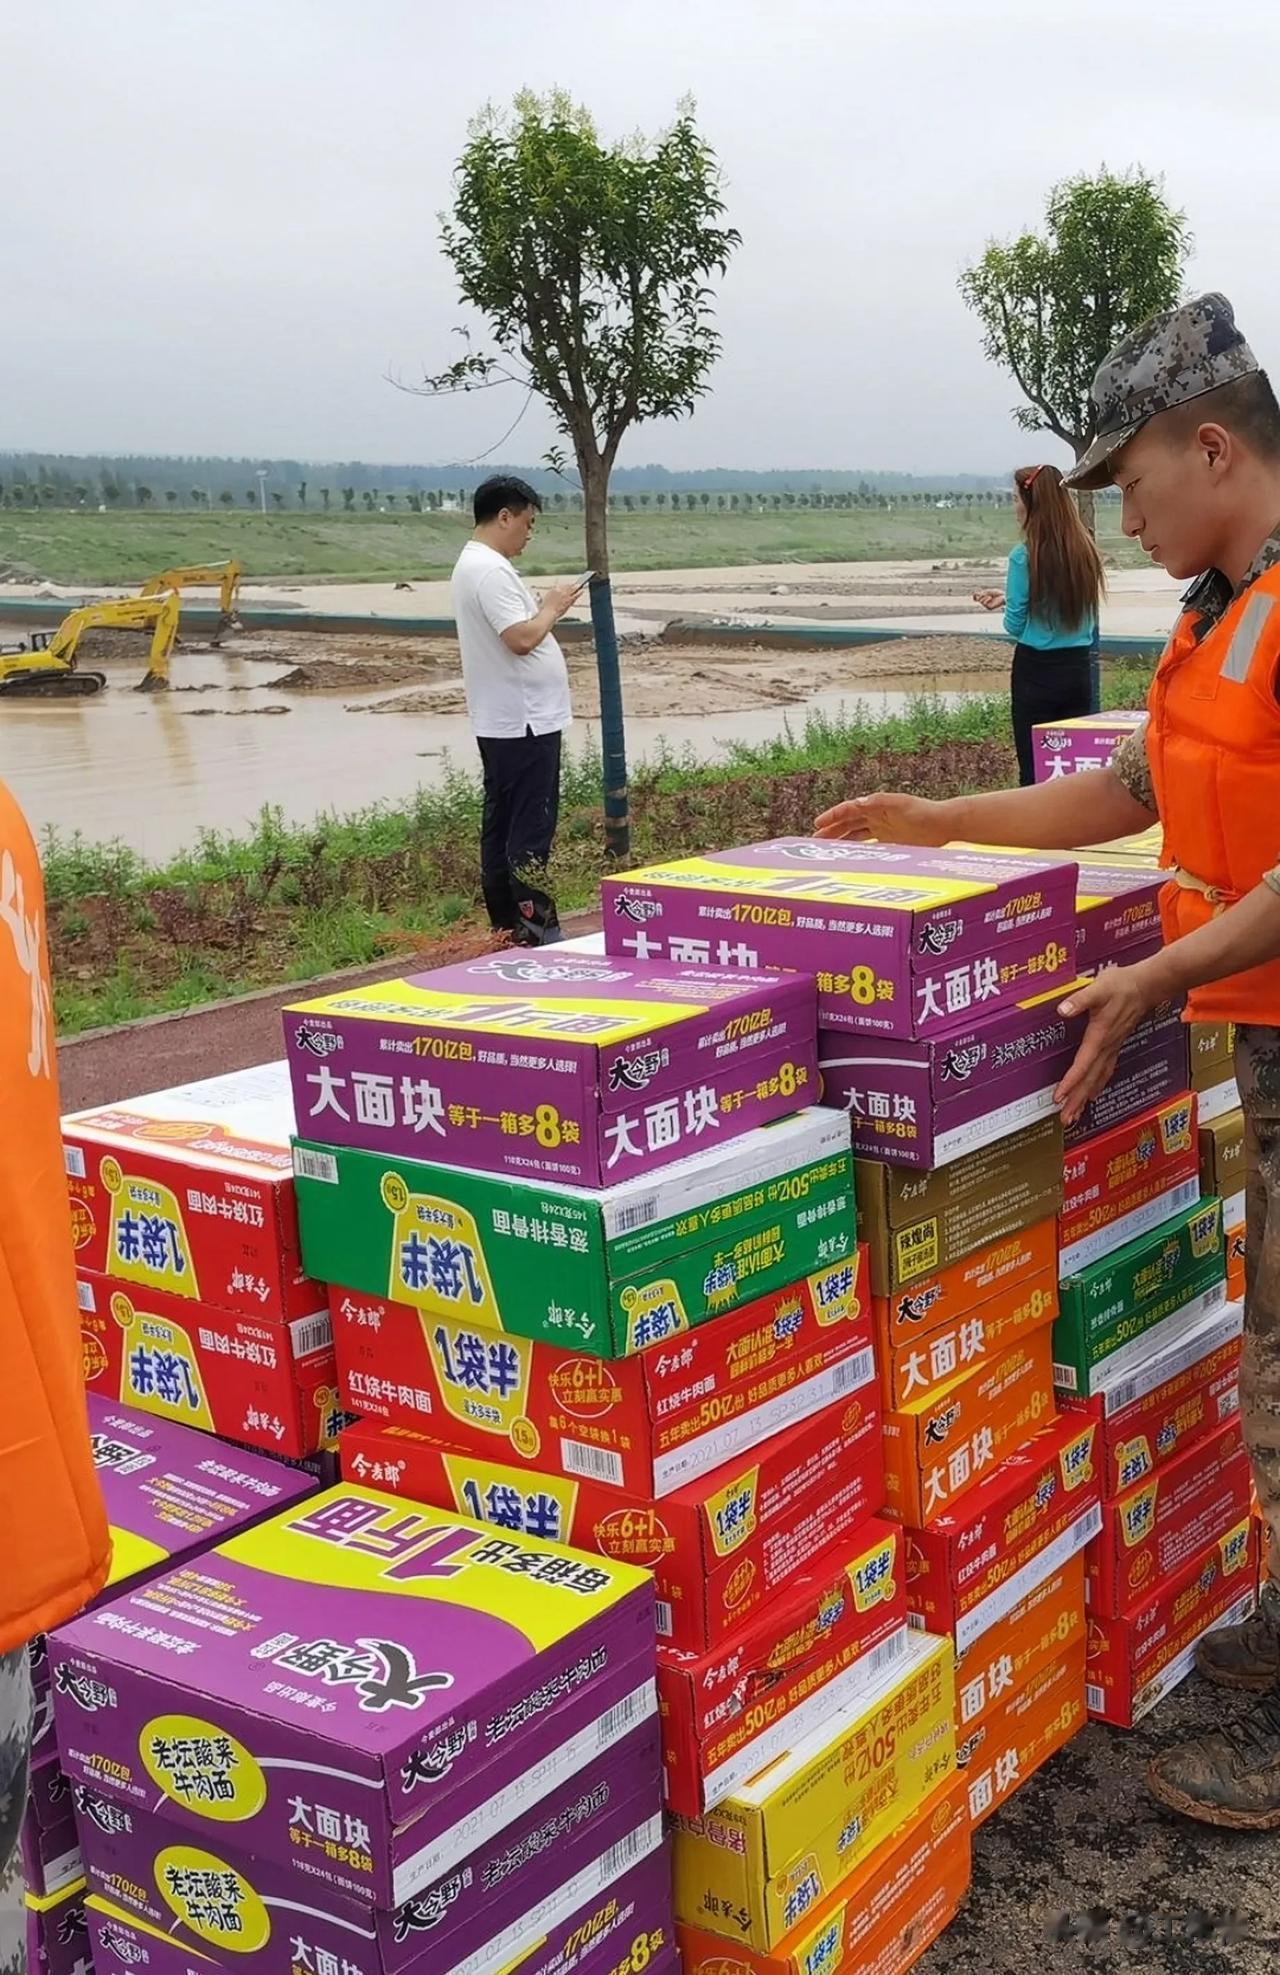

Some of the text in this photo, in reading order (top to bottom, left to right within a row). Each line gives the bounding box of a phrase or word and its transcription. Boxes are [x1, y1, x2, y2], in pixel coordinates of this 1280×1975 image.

[916, 957, 1000, 1025] 大面块
[306, 1066, 580, 1148] 大面块 等于一箱多8袋
[604, 1062, 808, 1169] 大面块 等于一箱多8袋
[843, 1088, 917, 1123] 大面块
[187, 1189, 264, 1229] 红烧牛肉面
[117, 1209, 187, 1275] 1袋半
[231, 1266, 271, 1302] 今麦郎
[400, 1231, 486, 1308] 1袋半
[815, 1266, 854, 1308] 1袋半
[340, 1297, 383, 1336] 今麦郎
[548, 1298, 596, 1339] 今麦郎
[633, 1301, 681, 1348] 1袋半
[199, 1327, 277, 1369] 红烧牛肉面
[432, 1325, 521, 1401] 1袋半
[654, 1346, 695, 1379] 今麦郎
[901, 1318, 985, 1400] 大面块
[130, 1344, 201, 1410] 1袋半
[347, 1369, 433, 1414] 红烧牛肉面
[548, 1359, 604, 1388] 快乐6+1
[246, 1404, 286, 1441] 今麦郎
[351, 1453, 401, 1489] 今麦郎
[924, 1425, 994, 1516] 大面块
[716, 1489, 751, 1537] 1袋半
[471, 1539, 612, 1596] 每箱多出
[855, 1550, 891, 1594] 1袋半
[273, 1639, 454, 1712] 大今野
[151, 1737, 240, 1769] 老坛酸菜
[401, 1722, 465, 1793] 大今野
[173, 1771, 235, 1802] 牛肉面
[287, 1796, 372, 1854] 大面块
[289, 1826, 374, 1873] 等于一箱多8袋
[165, 1866, 245, 1903] 老坛酸菜
[186, 1901, 243, 1932] 牛肉面
[703, 1890, 753, 1931] 今麦郎
